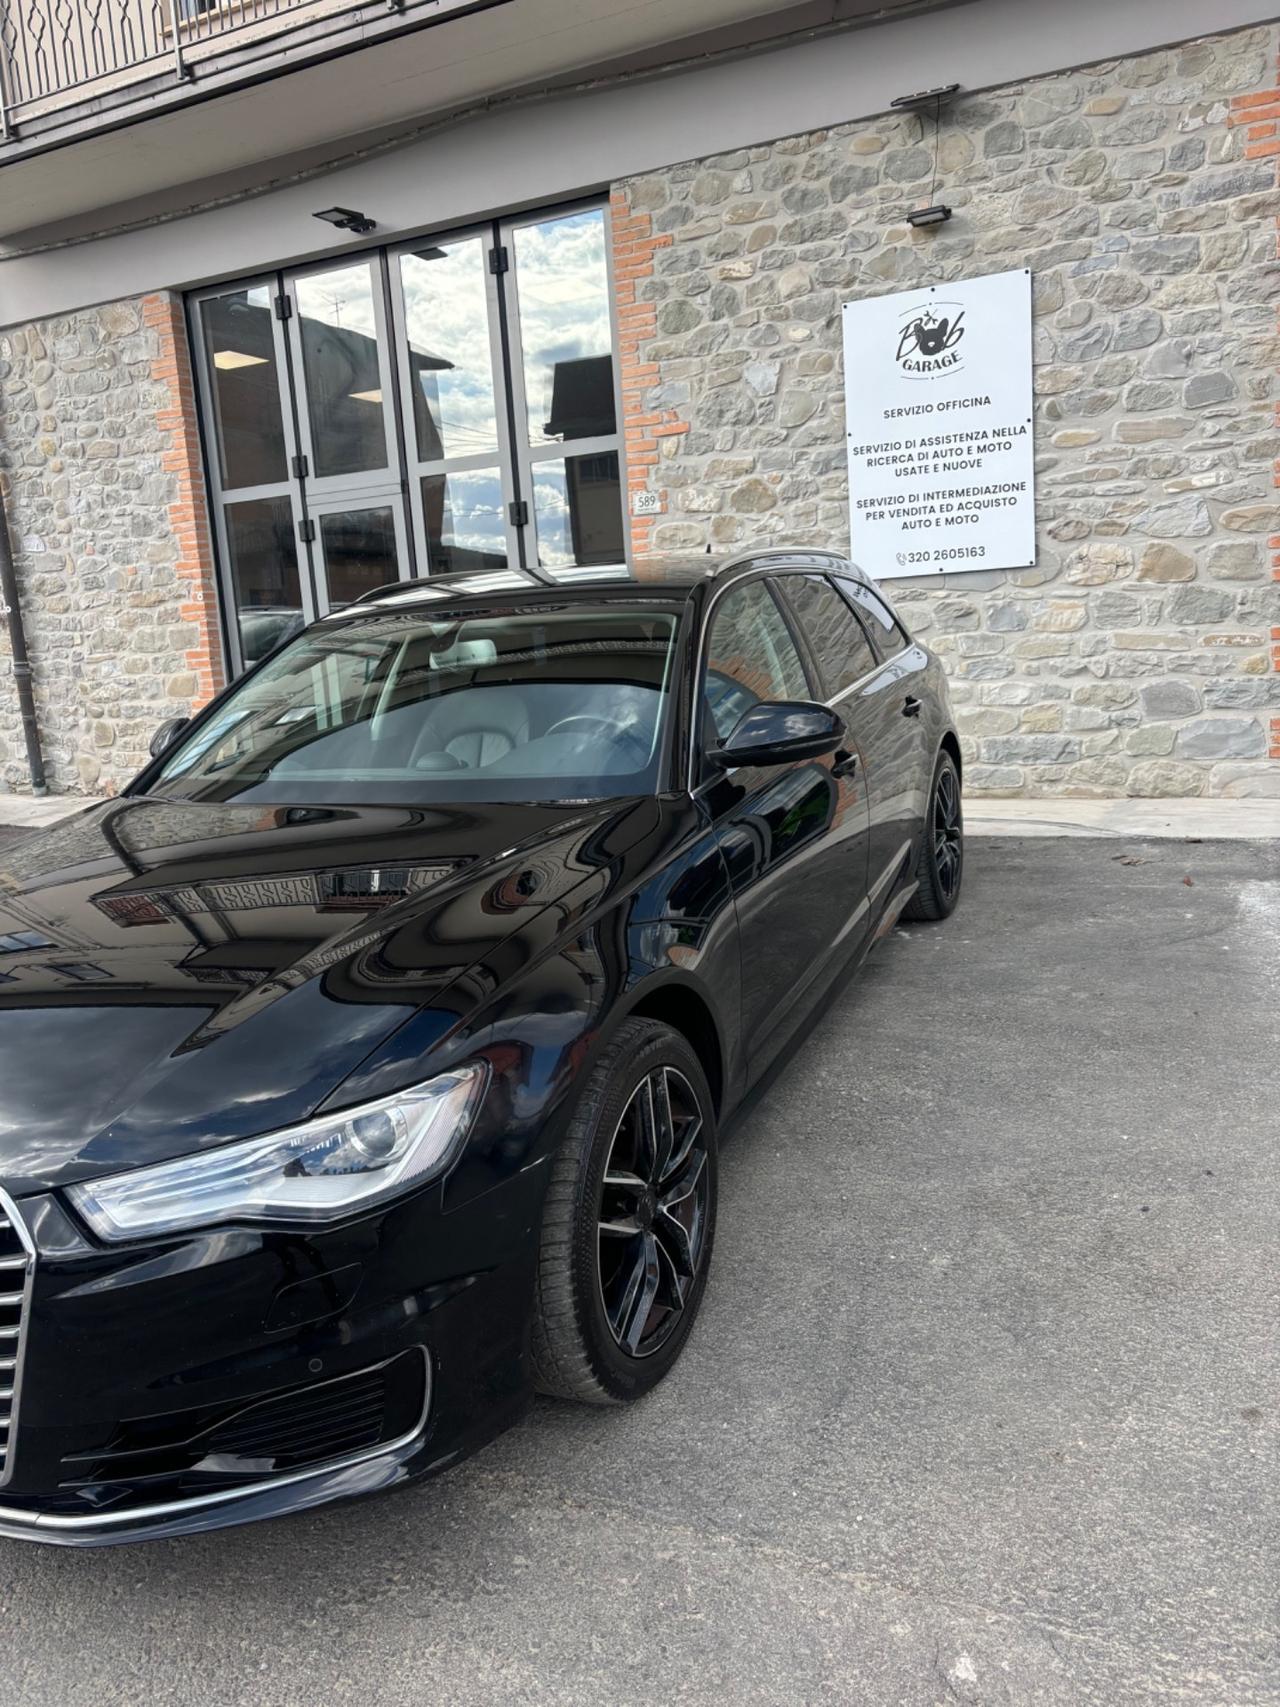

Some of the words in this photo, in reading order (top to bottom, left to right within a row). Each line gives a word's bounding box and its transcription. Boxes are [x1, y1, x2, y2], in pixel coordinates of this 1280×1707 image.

[902, 350, 963, 372] GARAGE
[883, 404, 934, 419] SERVIZIO
[936, 395, 991, 412] OFFICINA
[852, 441, 902, 456] SERVIZIO
[905, 439, 916, 449] DI
[919, 430, 988, 447] ASSISTENZA
[992, 425, 1027, 438] NELLA
[866, 453, 914, 468] RICERCA
[917, 451, 929, 461] DI
[932, 447, 964, 459] AUTO
[967, 445, 973, 455] E
[976, 441, 1012, 454] MOTO
[895, 464, 930, 477] USATE
[933, 463, 939, 473] E
[943, 458, 983, 472] NUOVE
[638, 495, 656, 508] 589
[856, 495, 905, 509] SERVIZIO
[908, 493, 920, 503] DI
[923, 481, 1027, 501] INTERMEDIAZIONE
[865, 511, 885, 521] PER
[888, 505, 936, 519] VENDITA
[939, 503, 954, 513] ED
[957, 496, 1018, 511] ACQUISTO
[901, 519, 932, 531] AUTO
[935, 517, 942, 527] E
[945, 514, 980, 526] MOTO
[907, 551, 931, 563] 320
[933, 546, 986, 561] 2605163
